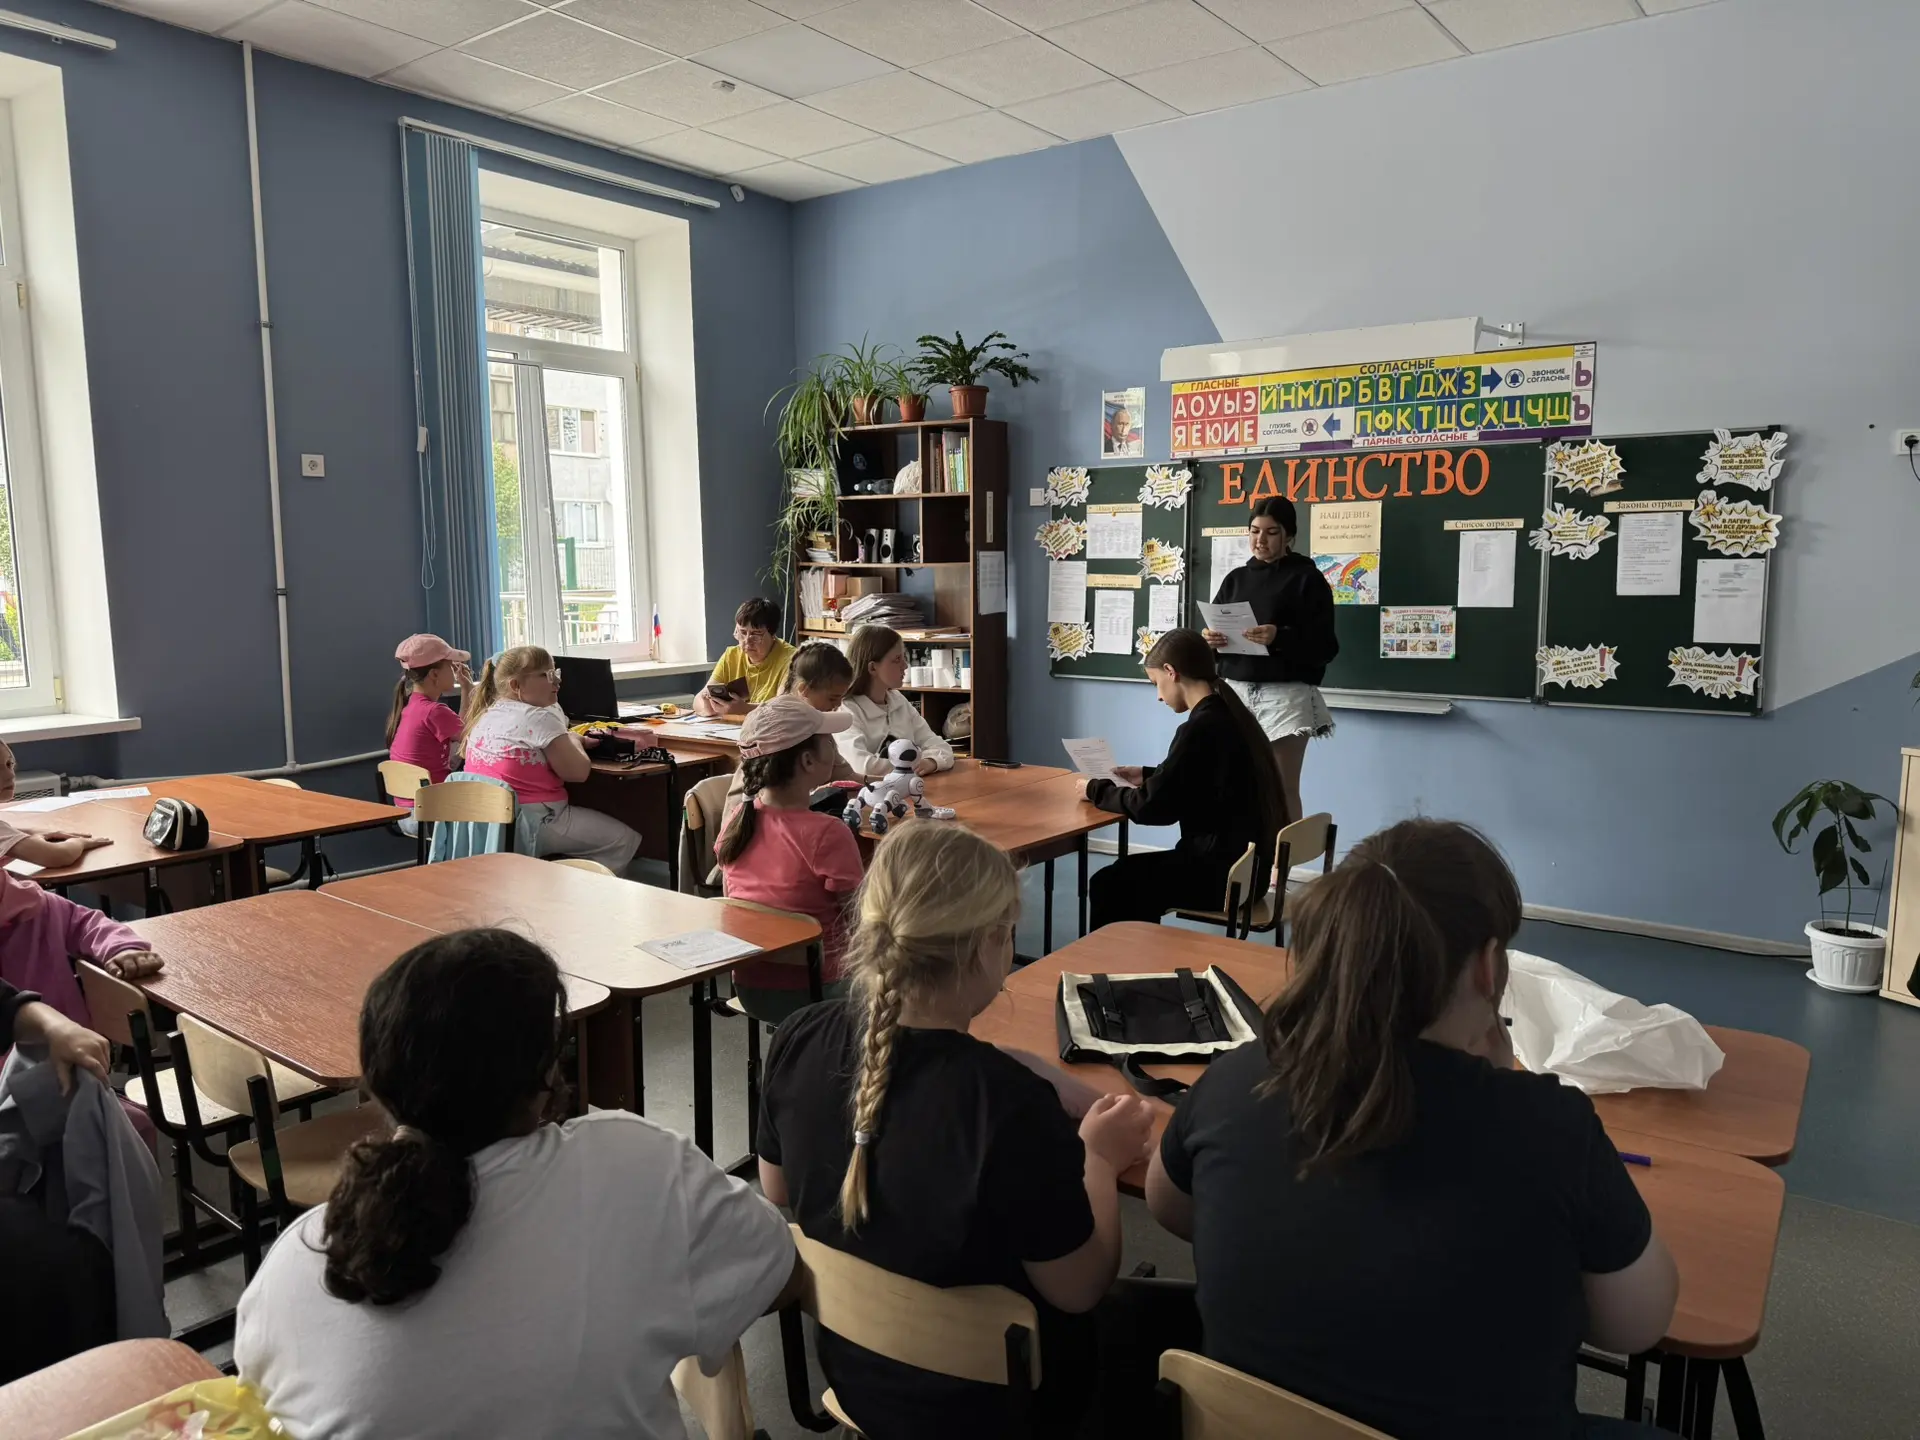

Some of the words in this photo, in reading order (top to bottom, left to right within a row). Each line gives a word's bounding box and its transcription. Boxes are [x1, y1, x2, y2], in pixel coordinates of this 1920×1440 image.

[1359, 358, 1435, 375] СОГЛАСНЫЕ
[1531, 368, 1566, 377] ЗВОНКИЕ
[1526, 374, 1570, 384] СОГЛАСНЫЕ
[1190, 378, 1240, 391] ГЛАСНЫЕ
[1269, 422, 1292, 430] ГЛУХИЕ
[1262, 428, 1298, 436] СОГЛАСНЫЕ
[1362, 434, 1404, 447] ПАРНЫЕ
[1406, 432, 1468, 444] СОГЛАСНЫЕ
[1218, 448, 1490, 510] ЕДИНСТВО
[1617, 501, 1649, 510] Законы
[1651, 500, 1683, 511] отряда
[1454, 520, 1484, 529] Список
[1486, 520, 1514, 530] отряда
